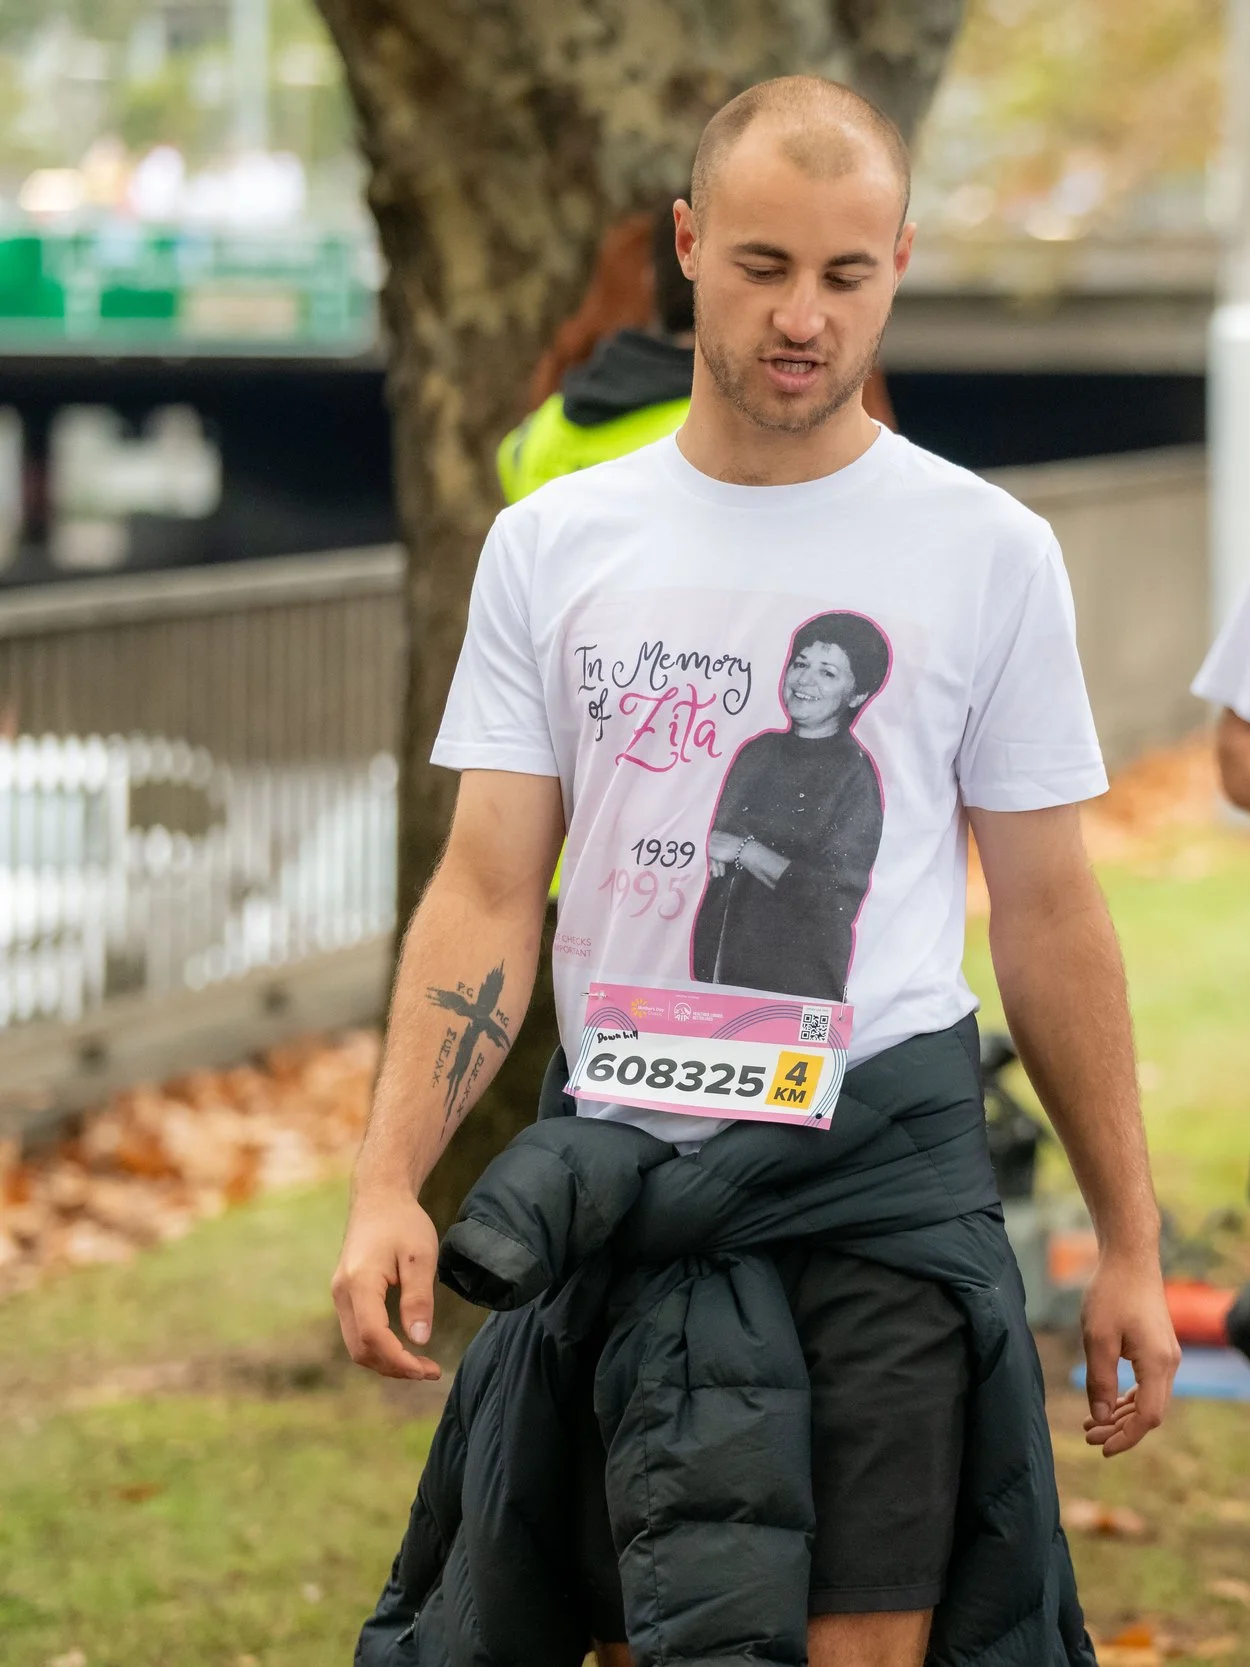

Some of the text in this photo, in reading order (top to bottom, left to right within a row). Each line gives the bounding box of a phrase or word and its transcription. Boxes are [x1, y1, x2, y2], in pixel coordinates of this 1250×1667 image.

[574, 640, 752, 715] In Memory
[588, 683, 722, 773] of Zita
[631, 838, 695, 869] 1939
[598, 867, 692, 920] 1995
[585, 1052, 767, 1098] 608325
[773, 1086, 807, 1104] KM
[785, 1060, 808, 1086] 4
